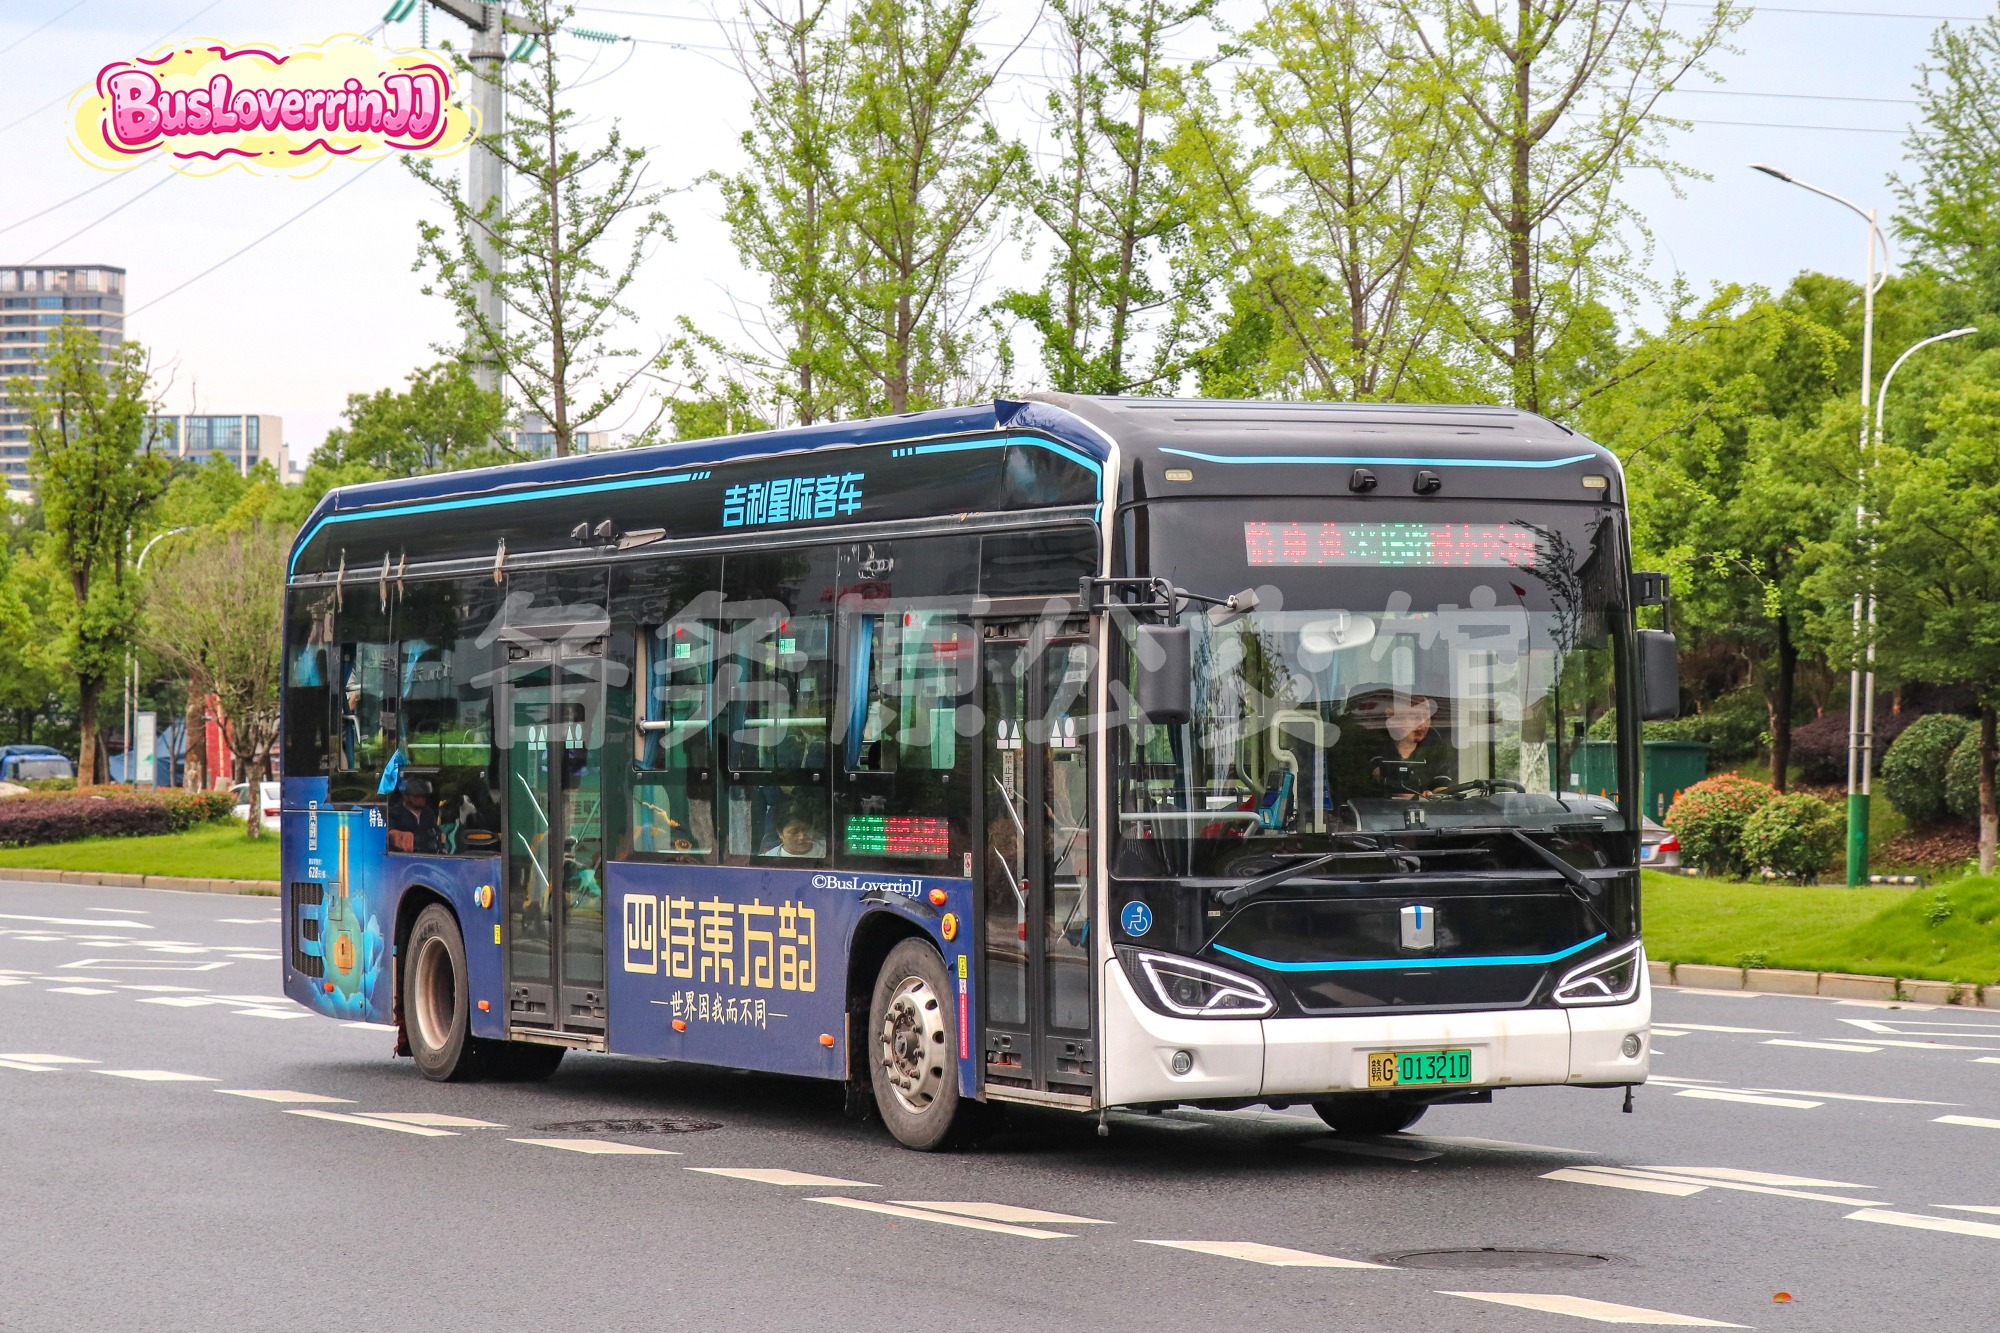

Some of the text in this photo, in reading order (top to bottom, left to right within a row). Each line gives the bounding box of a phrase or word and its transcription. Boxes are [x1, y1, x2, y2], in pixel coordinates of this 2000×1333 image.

[722, 472, 865, 527] 吉利星际客车
